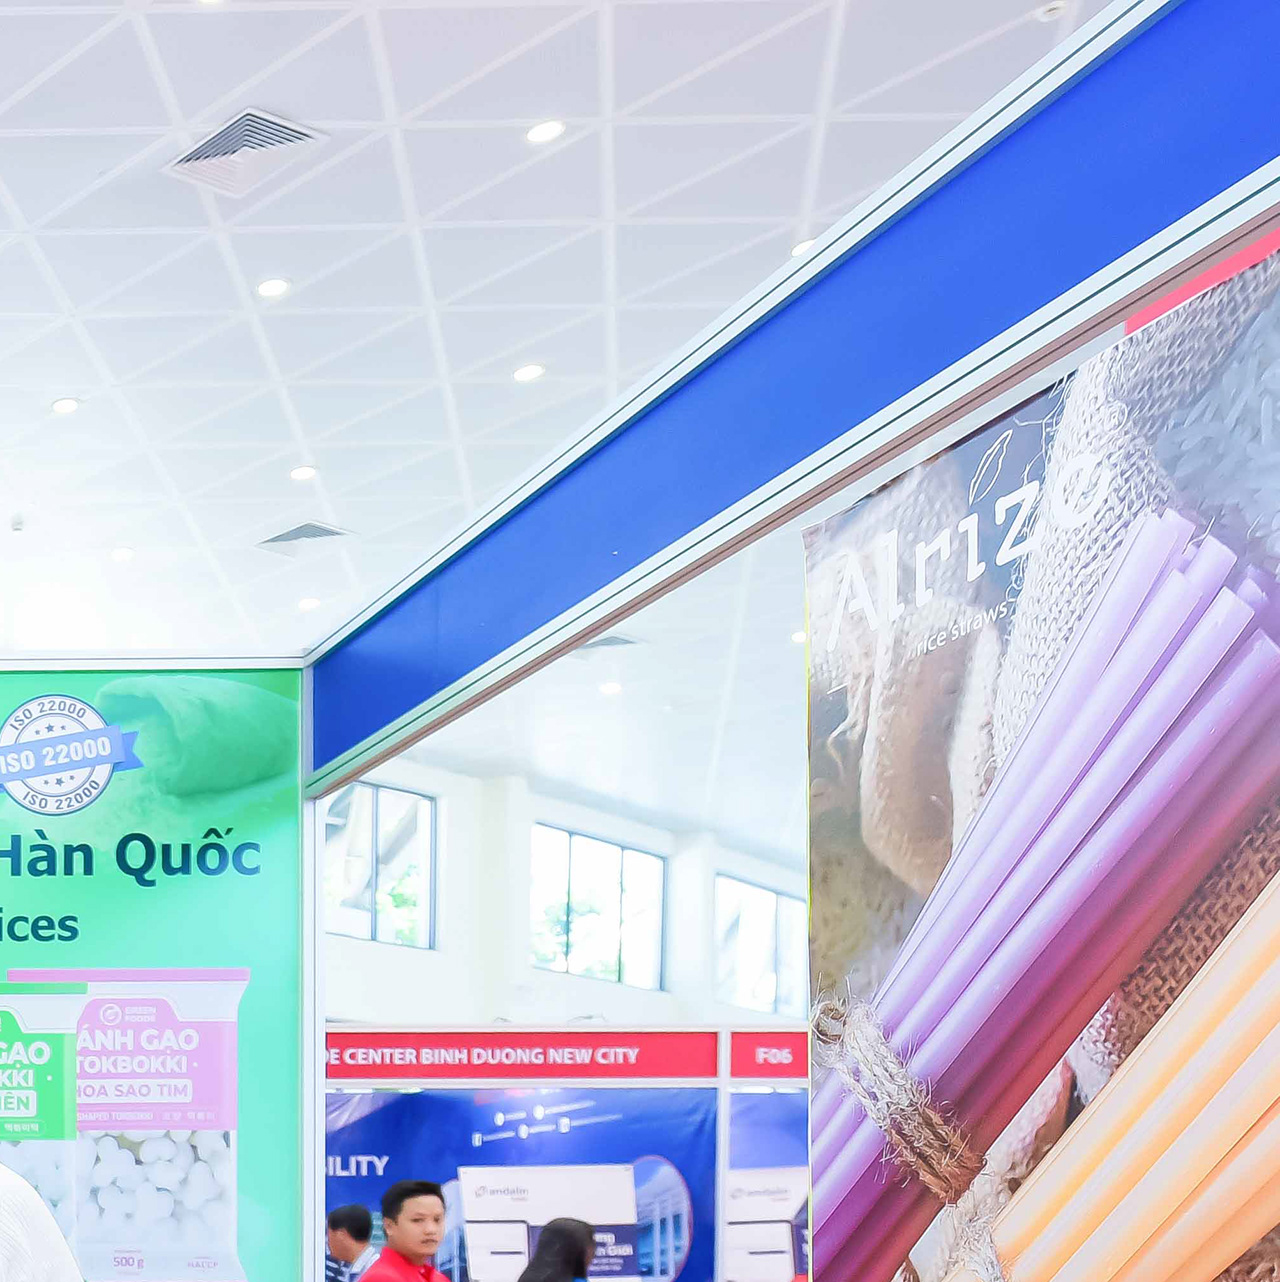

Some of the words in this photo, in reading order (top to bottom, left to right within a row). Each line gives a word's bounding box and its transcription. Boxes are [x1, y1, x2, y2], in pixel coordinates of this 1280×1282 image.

[916, 632, 947, 658] rice
[951, 601, 1008, 639] straws
[9, 708, 34, 732] ISO
[37, 699, 88, 719] 22000
[41, 735, 113, 767] 22000
[22, 790, 49, 810] ISO
[53, 779, 101, 810] 22000
[115, 827, 261, 887] Quốc
[140, 1028, 200, 1054] GẠO
[343, 1047, 417, 1065] CENTER
[421, 1047, 469, 1065] BINH
[473, 1047, 546, 1065] DUONG
[548, 1047, 593, 1065] NEW
[595, 1047, 639, 1065] CITY
[114, 1084, 152, 1097] SAO
[113, 1256, 135, 1267] 500
[137, 1258, 144, 1269] g
